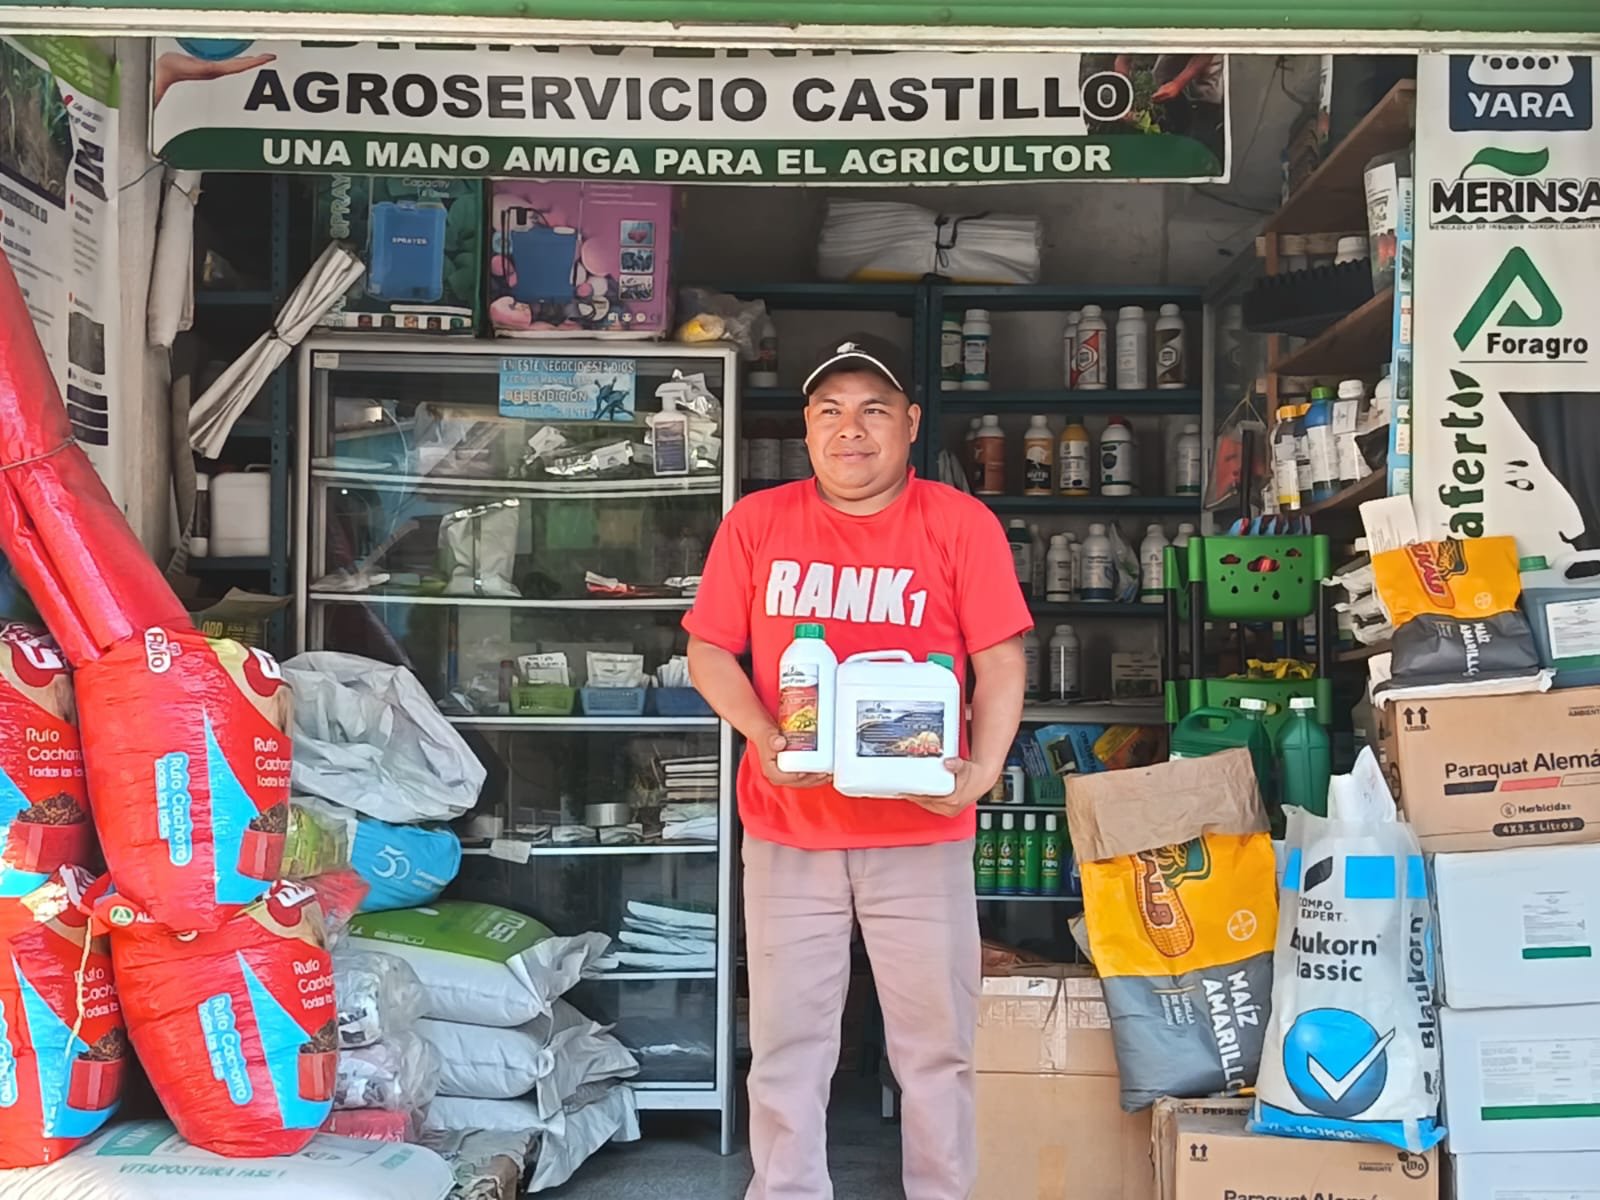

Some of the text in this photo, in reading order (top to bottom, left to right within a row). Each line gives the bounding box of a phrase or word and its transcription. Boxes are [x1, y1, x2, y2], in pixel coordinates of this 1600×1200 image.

[244, 69, 1134, 122] AGROSERVICIO CASTILLO
[1469, 92, 1574, 119] YARA
[263, 138, 1112, 175] UNA MANO AMIGA PARA EL AGRICULTOR
[1432, 182, 1600, 213] MERINSA
[1487, 332, 1588, 359] Foragro
[147, 632, 167, 668] Rufo
[254, 737, 278, 752] Rufo
[170, 757, 184, 790] Rufo
[1445, 758, 1528, 779] Paraquat
[1518, 802, 1572, 814] Herbicidas
[1539, 822, 1575, 832] Litros
[1301, 908, 1342, 922] EXPERT
[293, 960, 320, 975] Rufo
[1227, 970, 1262, 1028] MAÍZ
[211, 996, 230, 1031] Rufo
